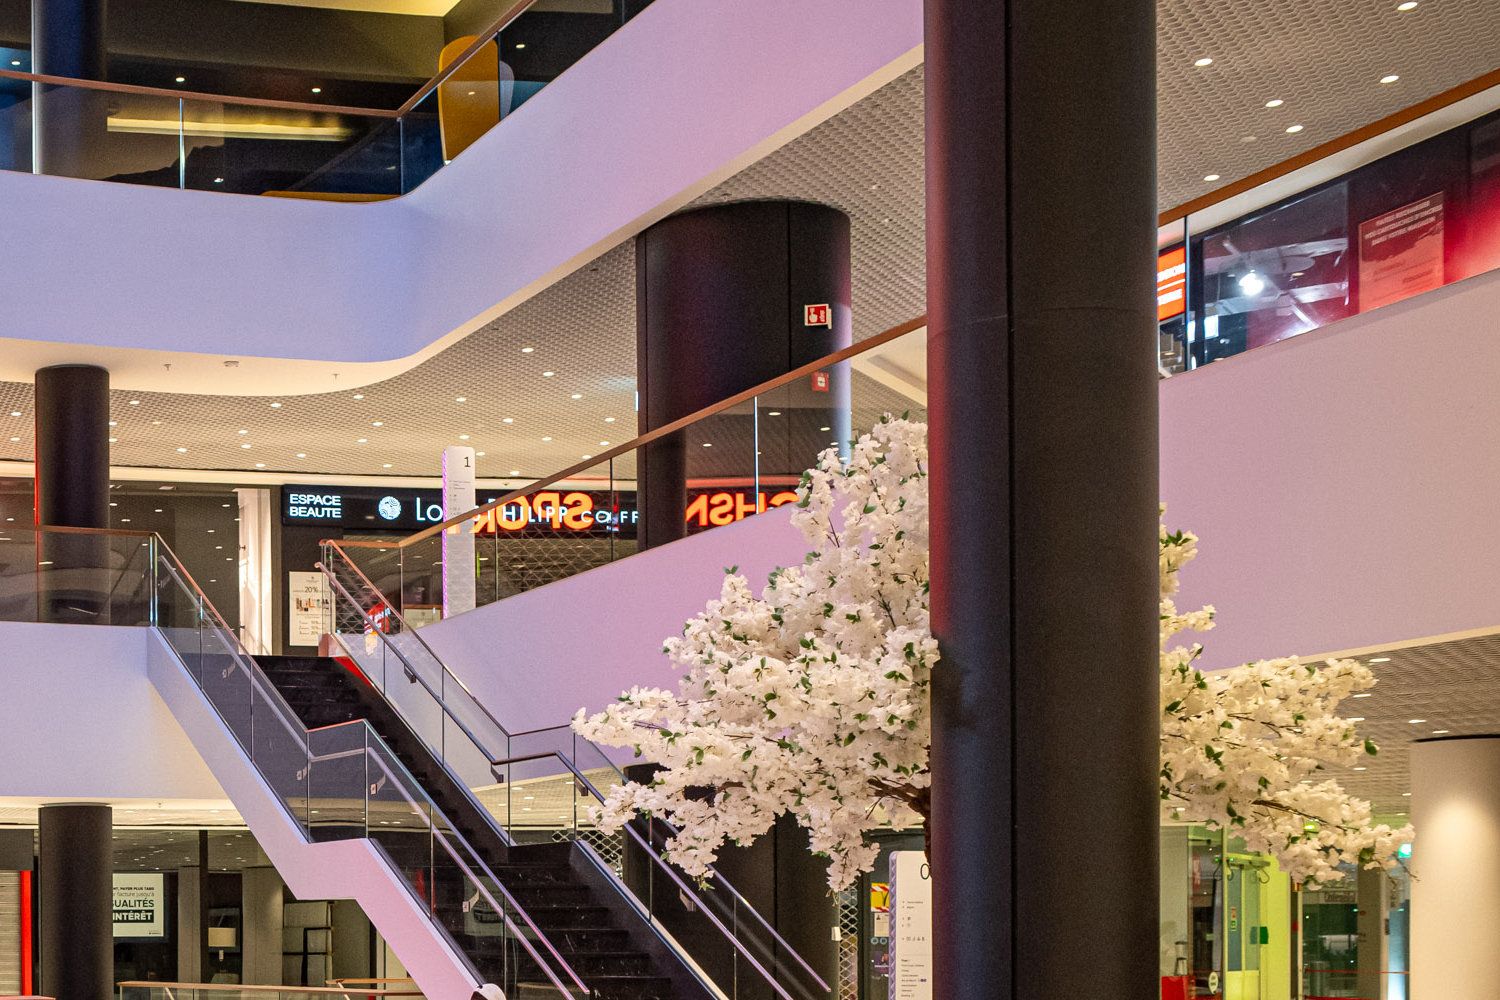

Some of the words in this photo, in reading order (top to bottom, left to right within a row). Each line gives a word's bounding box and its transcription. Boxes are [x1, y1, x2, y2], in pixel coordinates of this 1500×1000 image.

[464, 456, 471, 467] 1
[289, 493, 342, 506] ESPACE
[289, 506, 342, 518] BEAUTE
[112, 897, 154, 908] UALITÉS
[112, 910, 153, 921] INTÉRÊT
